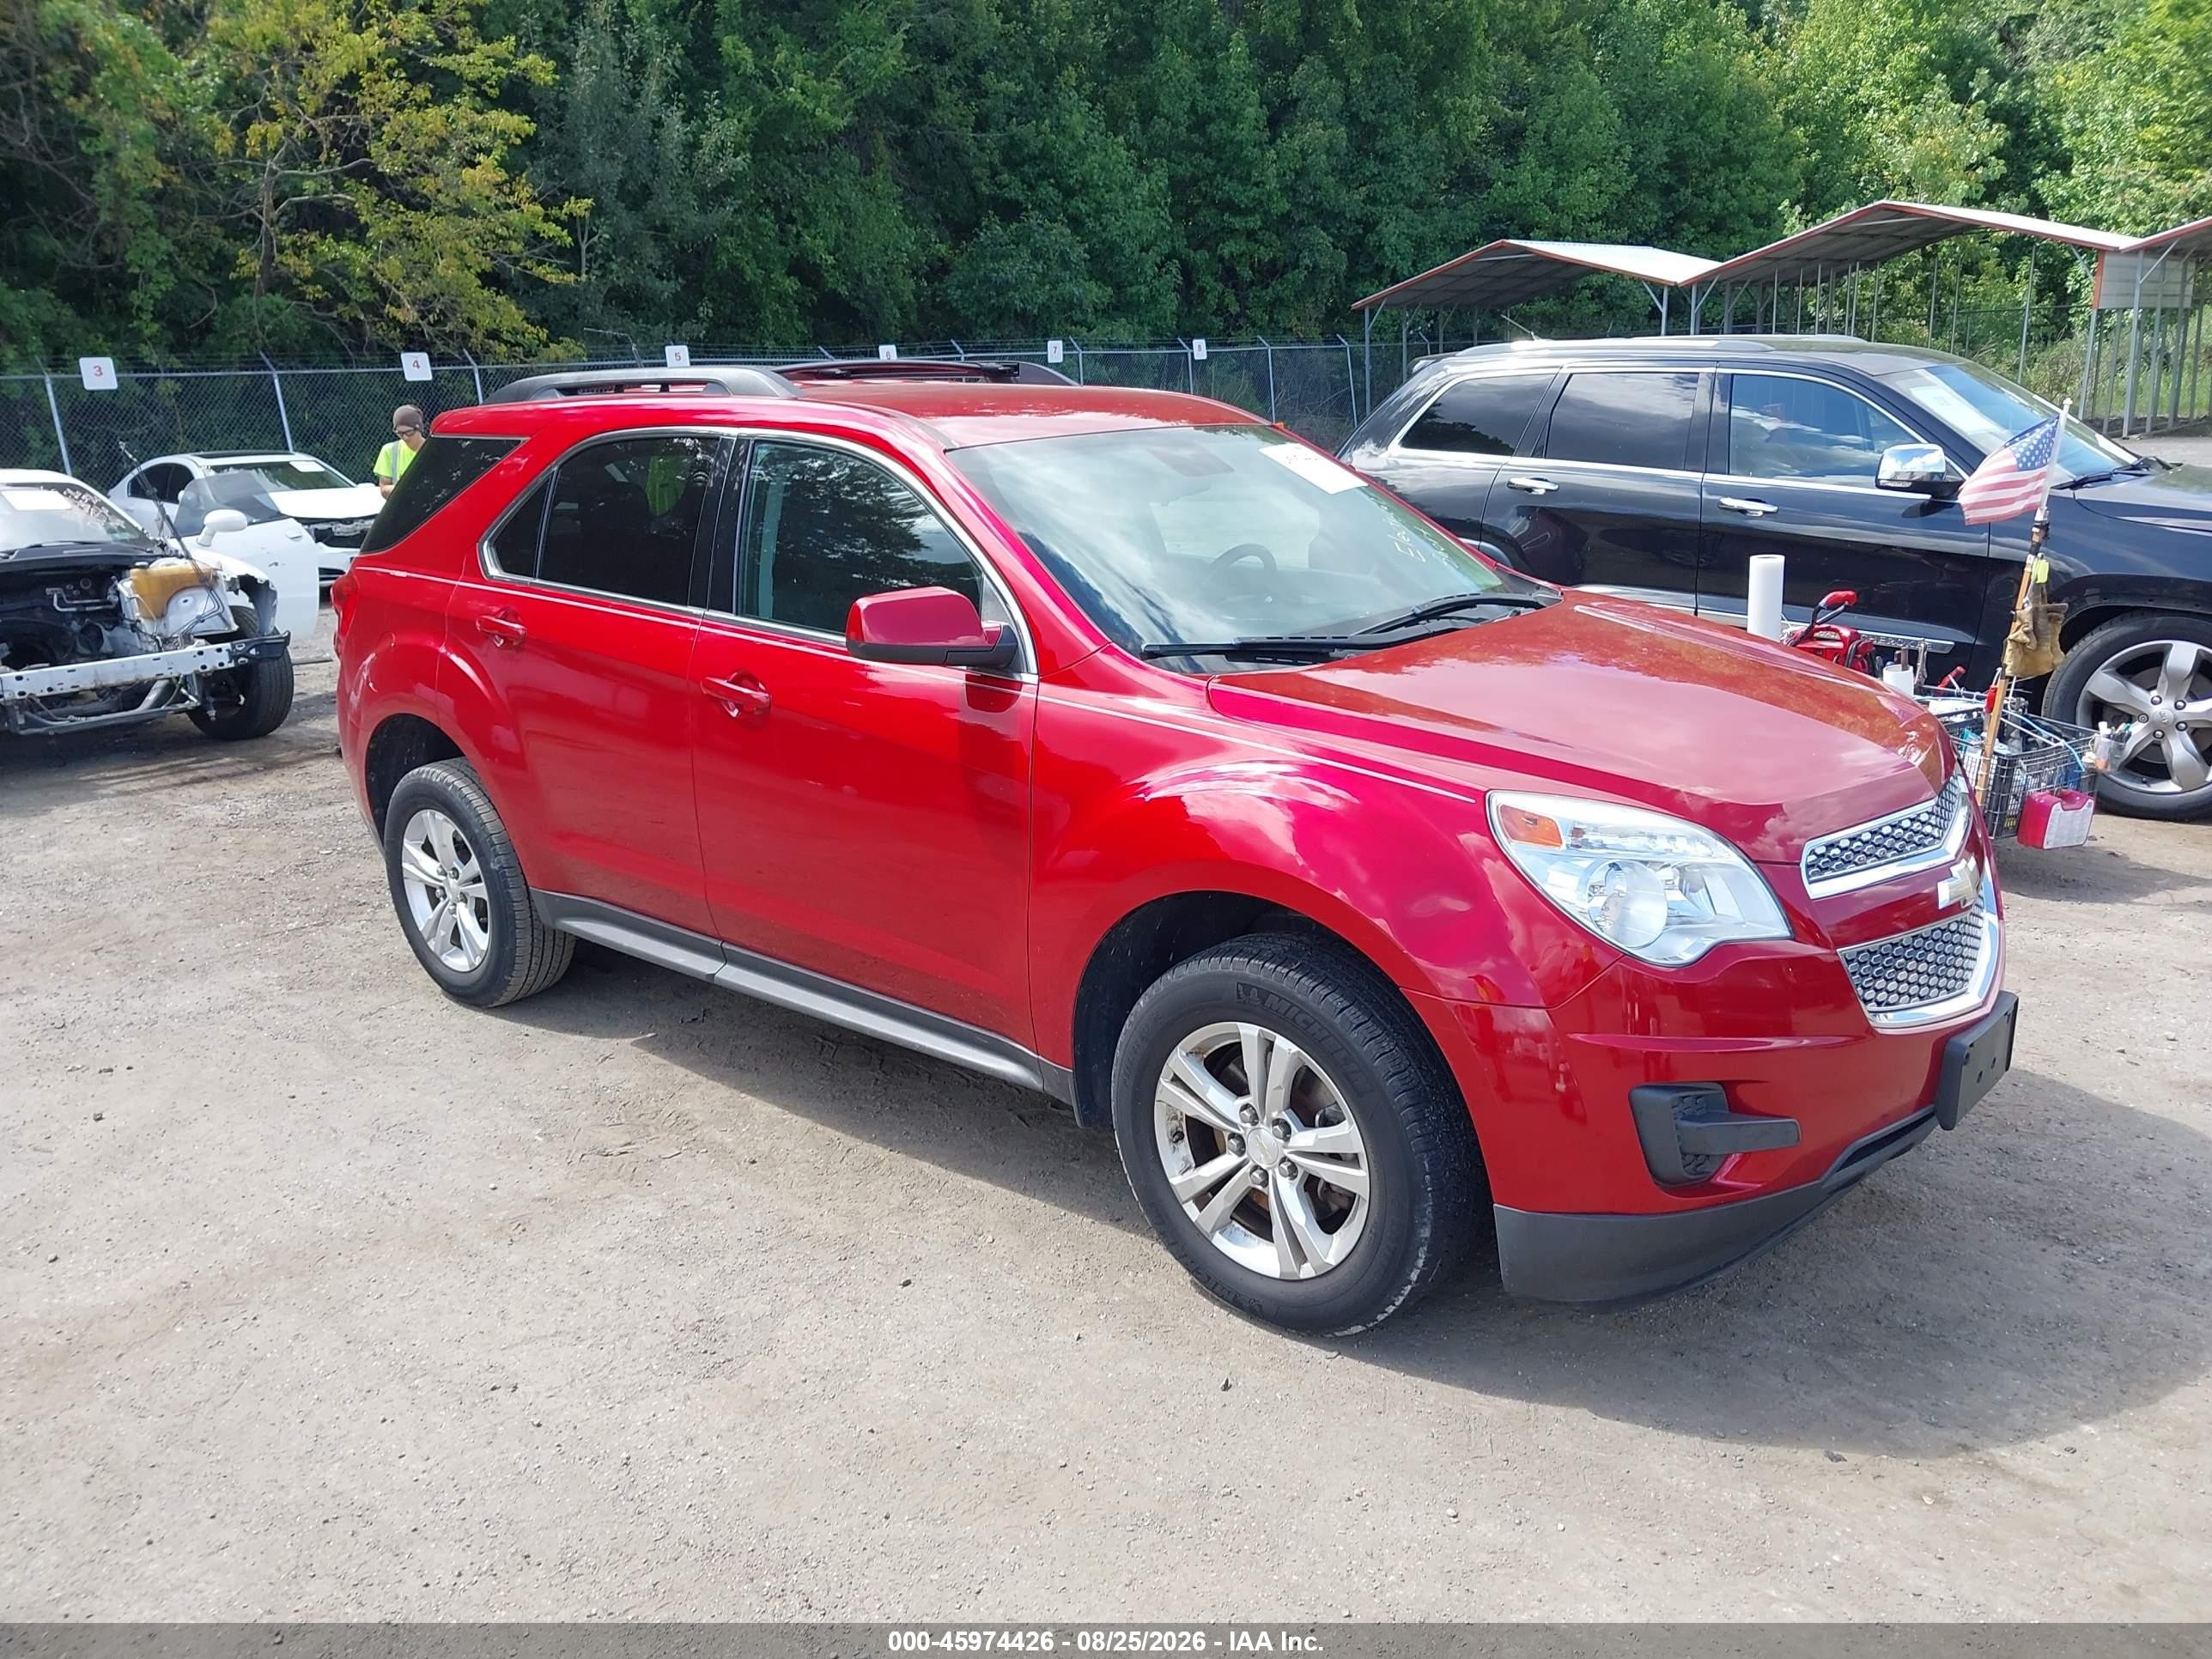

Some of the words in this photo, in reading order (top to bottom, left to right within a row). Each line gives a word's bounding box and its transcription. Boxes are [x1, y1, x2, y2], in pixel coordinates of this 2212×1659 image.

[674, 352, 682, 362] 5
[411, 359, 421, 369] 4
[92, 365, 104, 377] 3
